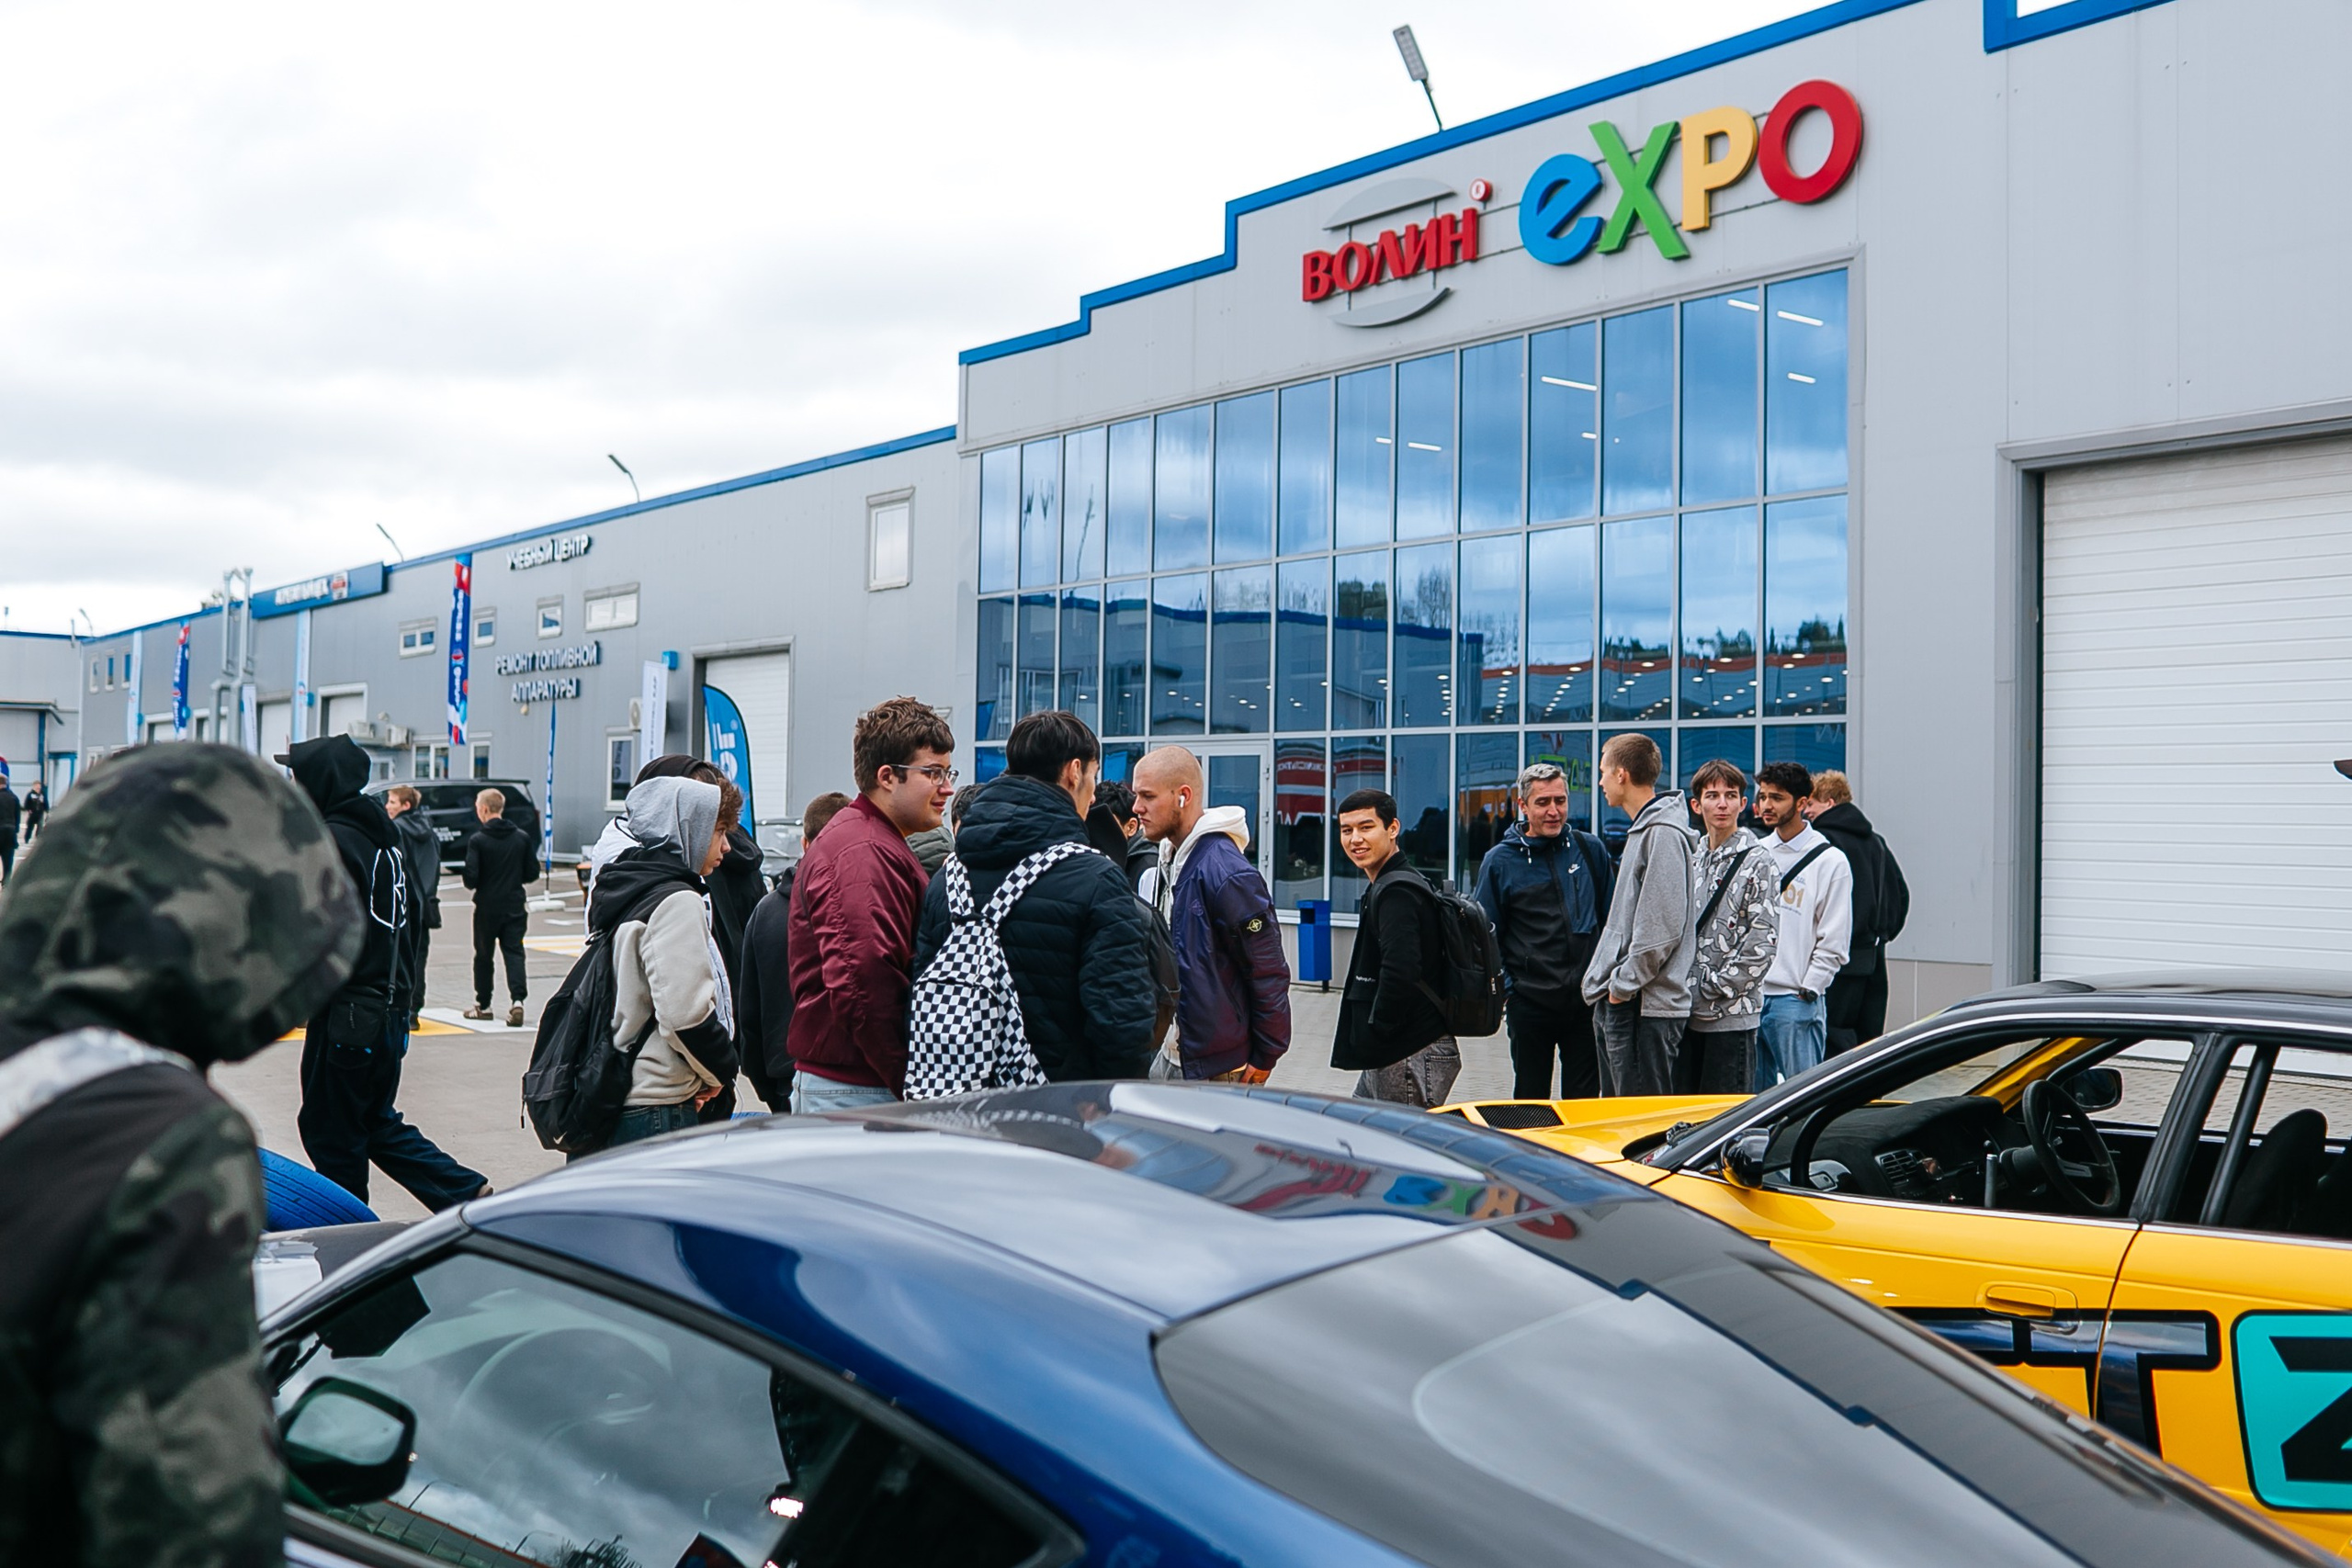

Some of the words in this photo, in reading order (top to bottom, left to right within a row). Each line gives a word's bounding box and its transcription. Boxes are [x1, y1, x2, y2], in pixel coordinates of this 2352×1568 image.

[1302, 208, 1478, 303] ВОЛИН
[506, 536, 556, 570] УЧЕБНЫЙ
[555, 534, 592, 563] ЦЕНТР
[495, 650, 536, 676] РЕМОНТ
[536, 641, 601, 671] ТОПЛИВНОЙ
[511, 677, 581, 705] АППАРАТУРЫ
